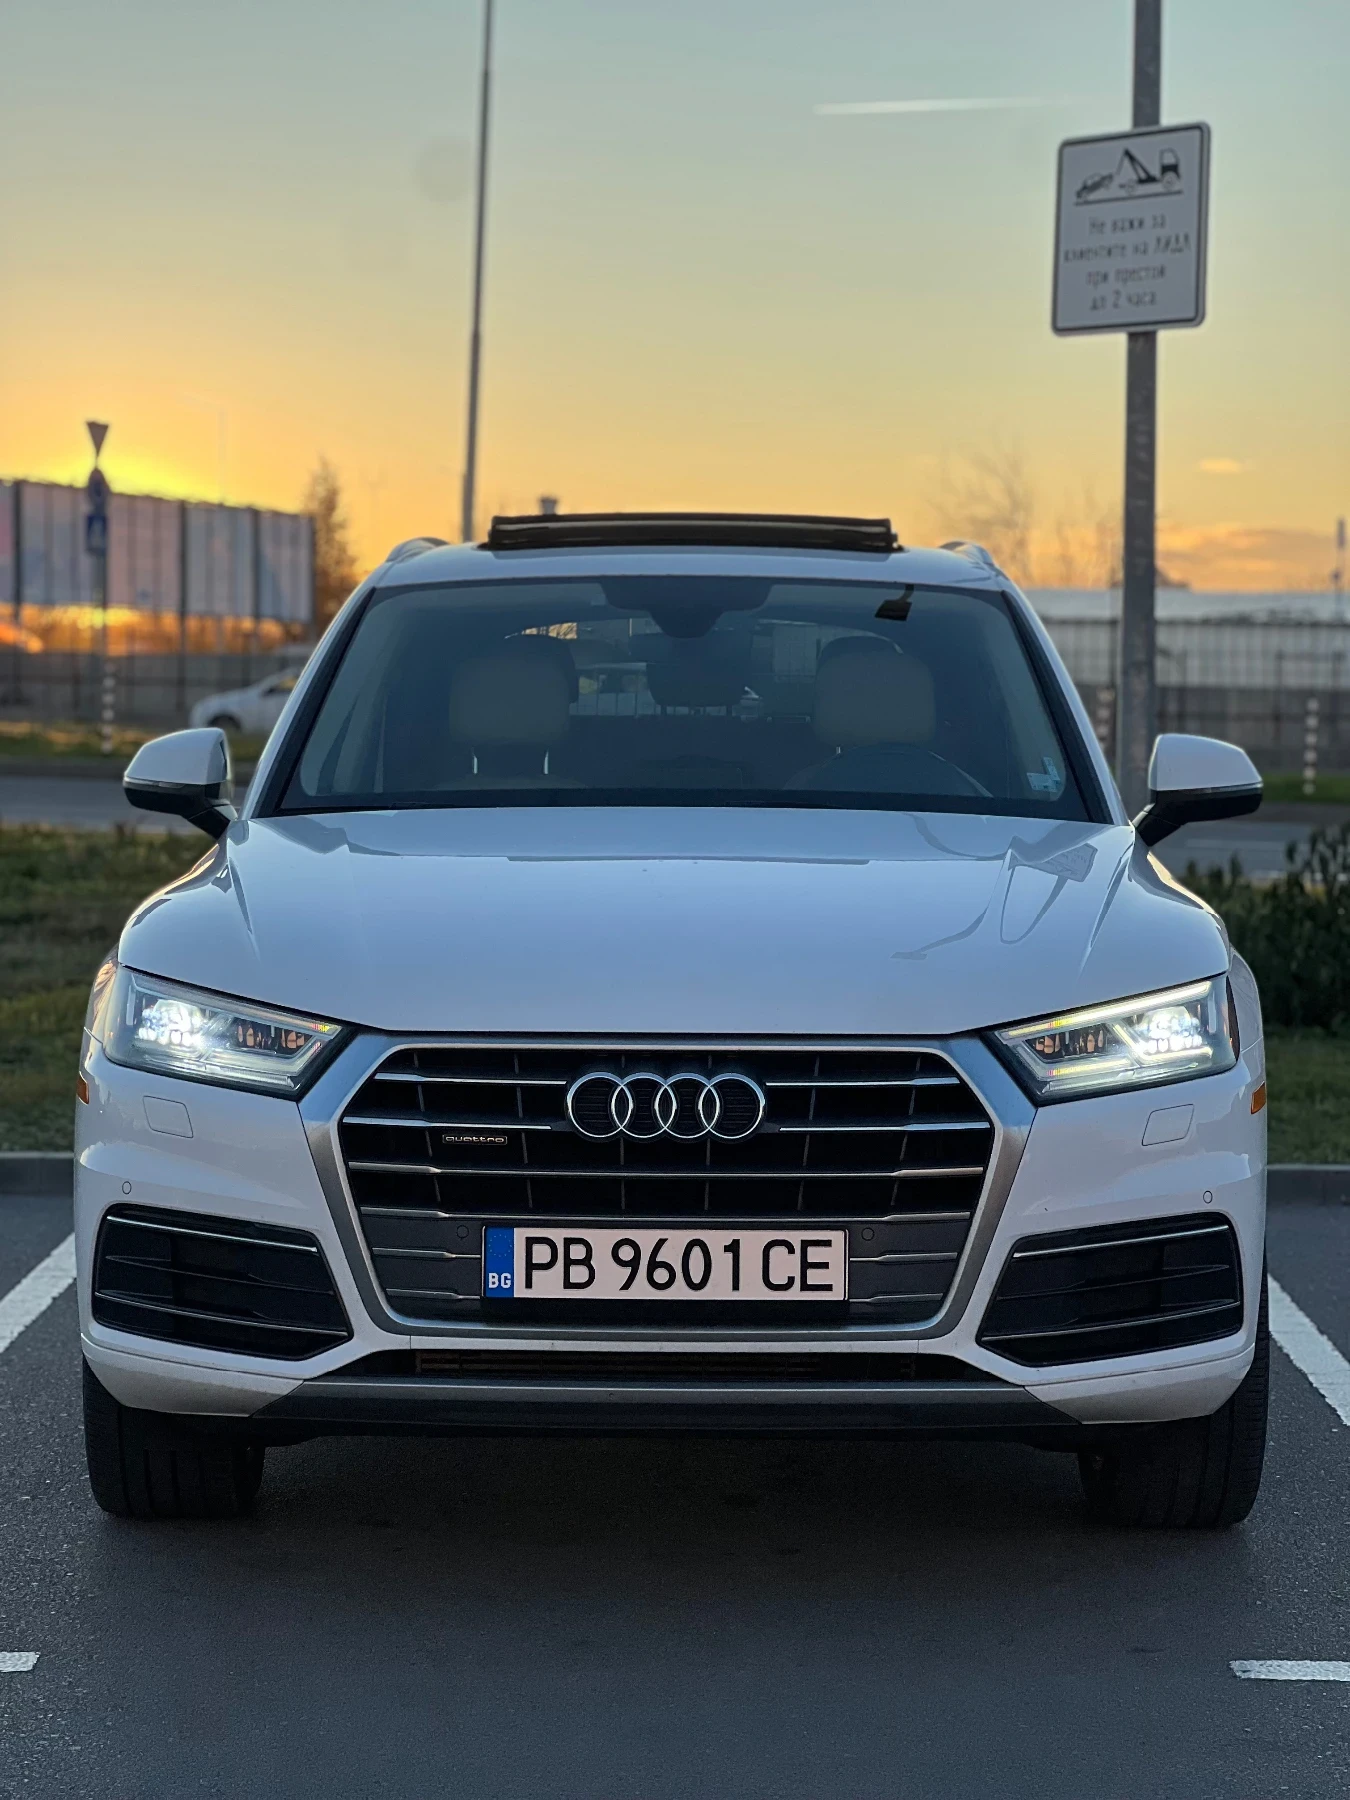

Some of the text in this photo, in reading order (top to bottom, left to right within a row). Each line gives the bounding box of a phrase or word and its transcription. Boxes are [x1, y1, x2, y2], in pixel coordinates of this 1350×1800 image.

[1112, 288, 1121, 310] 2
[524, 1236, 834, 1292] PB 9601 CE
[488, 1272, 512, 1289] BG
